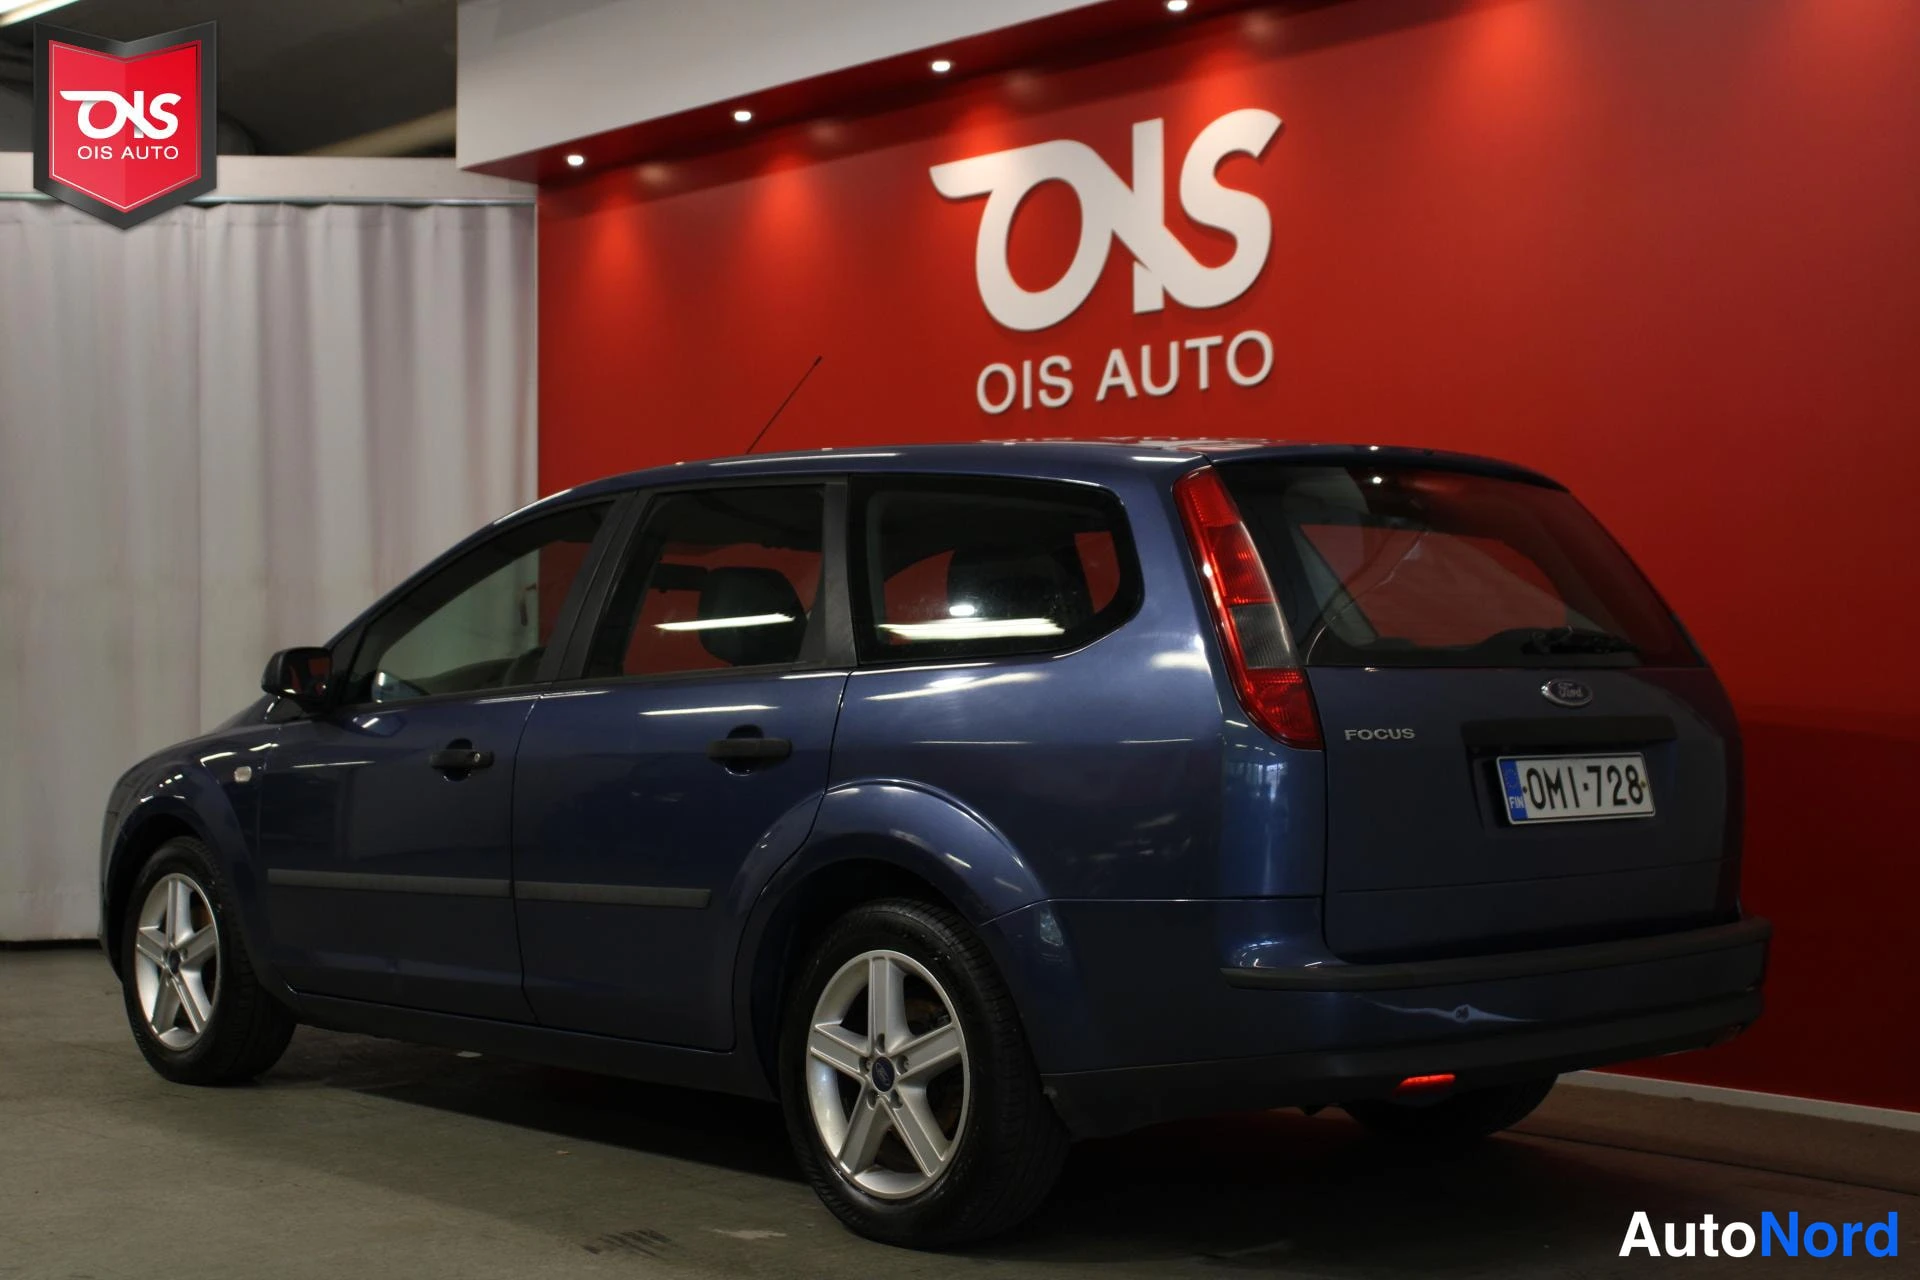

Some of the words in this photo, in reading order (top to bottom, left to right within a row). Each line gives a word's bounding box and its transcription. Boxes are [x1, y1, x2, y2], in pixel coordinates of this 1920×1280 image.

[929, 108, 1282, 332] OIS
[976, 355, 1073, 414] OIS
[1096, 330, 1274, 402] AUTO
[1344, 727, 1416, 741] FOCUS
[1508, 795, 1525, 809] FIN
[1526, 764, 1644, 810] OMI-728
